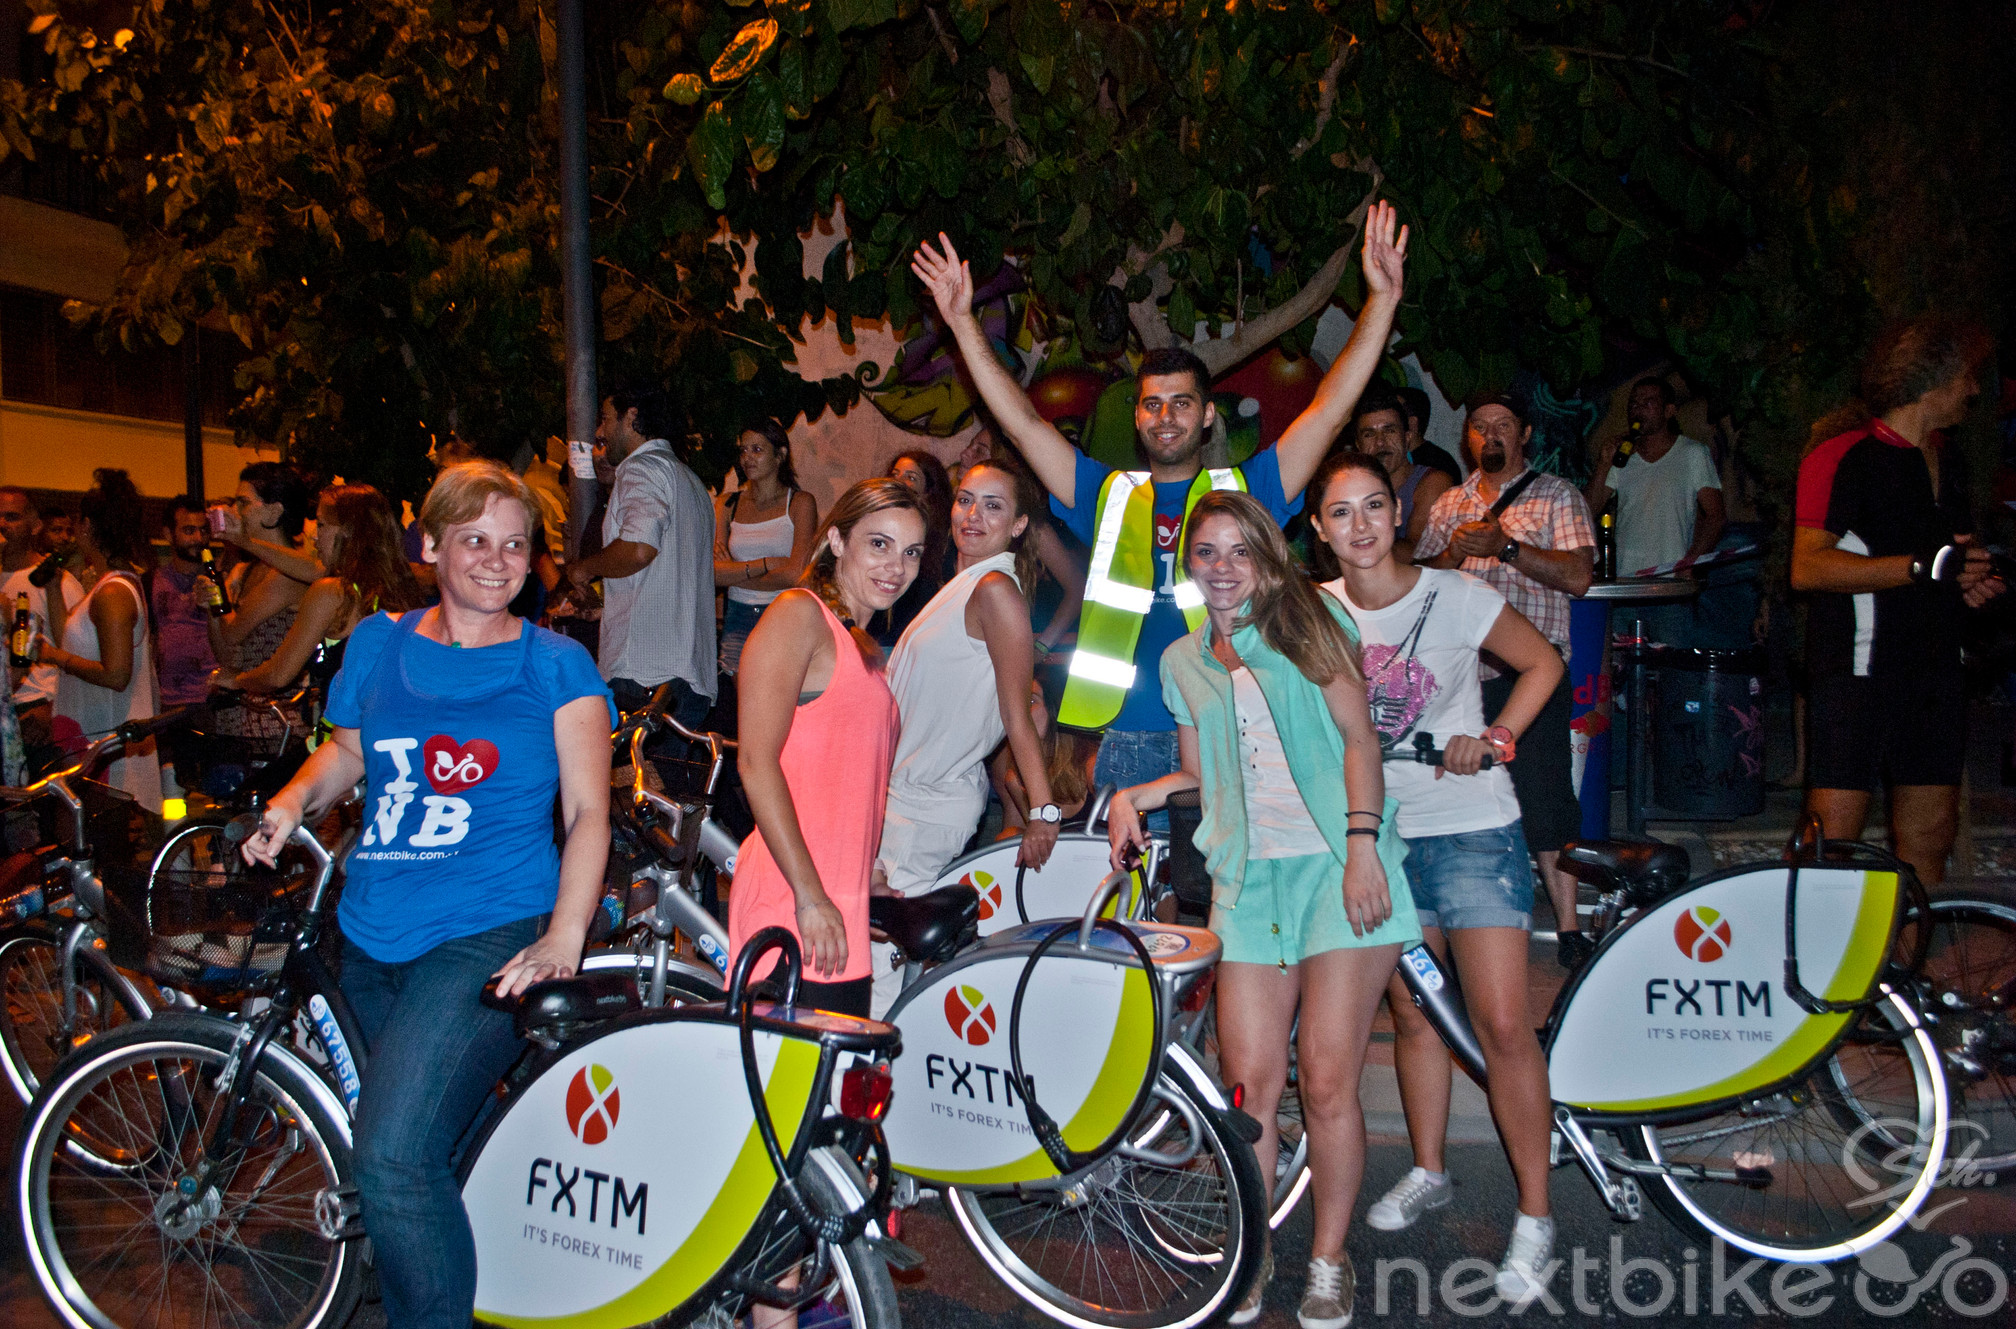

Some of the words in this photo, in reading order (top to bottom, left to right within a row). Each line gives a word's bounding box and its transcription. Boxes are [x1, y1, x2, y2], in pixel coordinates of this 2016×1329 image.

[373, 737, 418, 795] I
[1645, 978, 1772, 1017] FXTM
[321, 1020, 358, 1095] 67558
[1647, 1027, 1675, 1040] IT'S
[1680, 1028, 1732, 1041] FOREX
[1736, 1030, 1773, 1042] TIME
[925, 1053, 1037, 1108] FXTM
[930, 1102, 954, 1118] IT'S
[958, 1108, 1004, 1130] FOREX
[1007, 1120, 1032, 1136] TIM
[526, 1157, 649, 1236] FXTM
[523, 1223, 549, 1244] IT'S
[551, 1231, 602, 1260] FOREX
[606, 1246, 643, 1270] TIME
